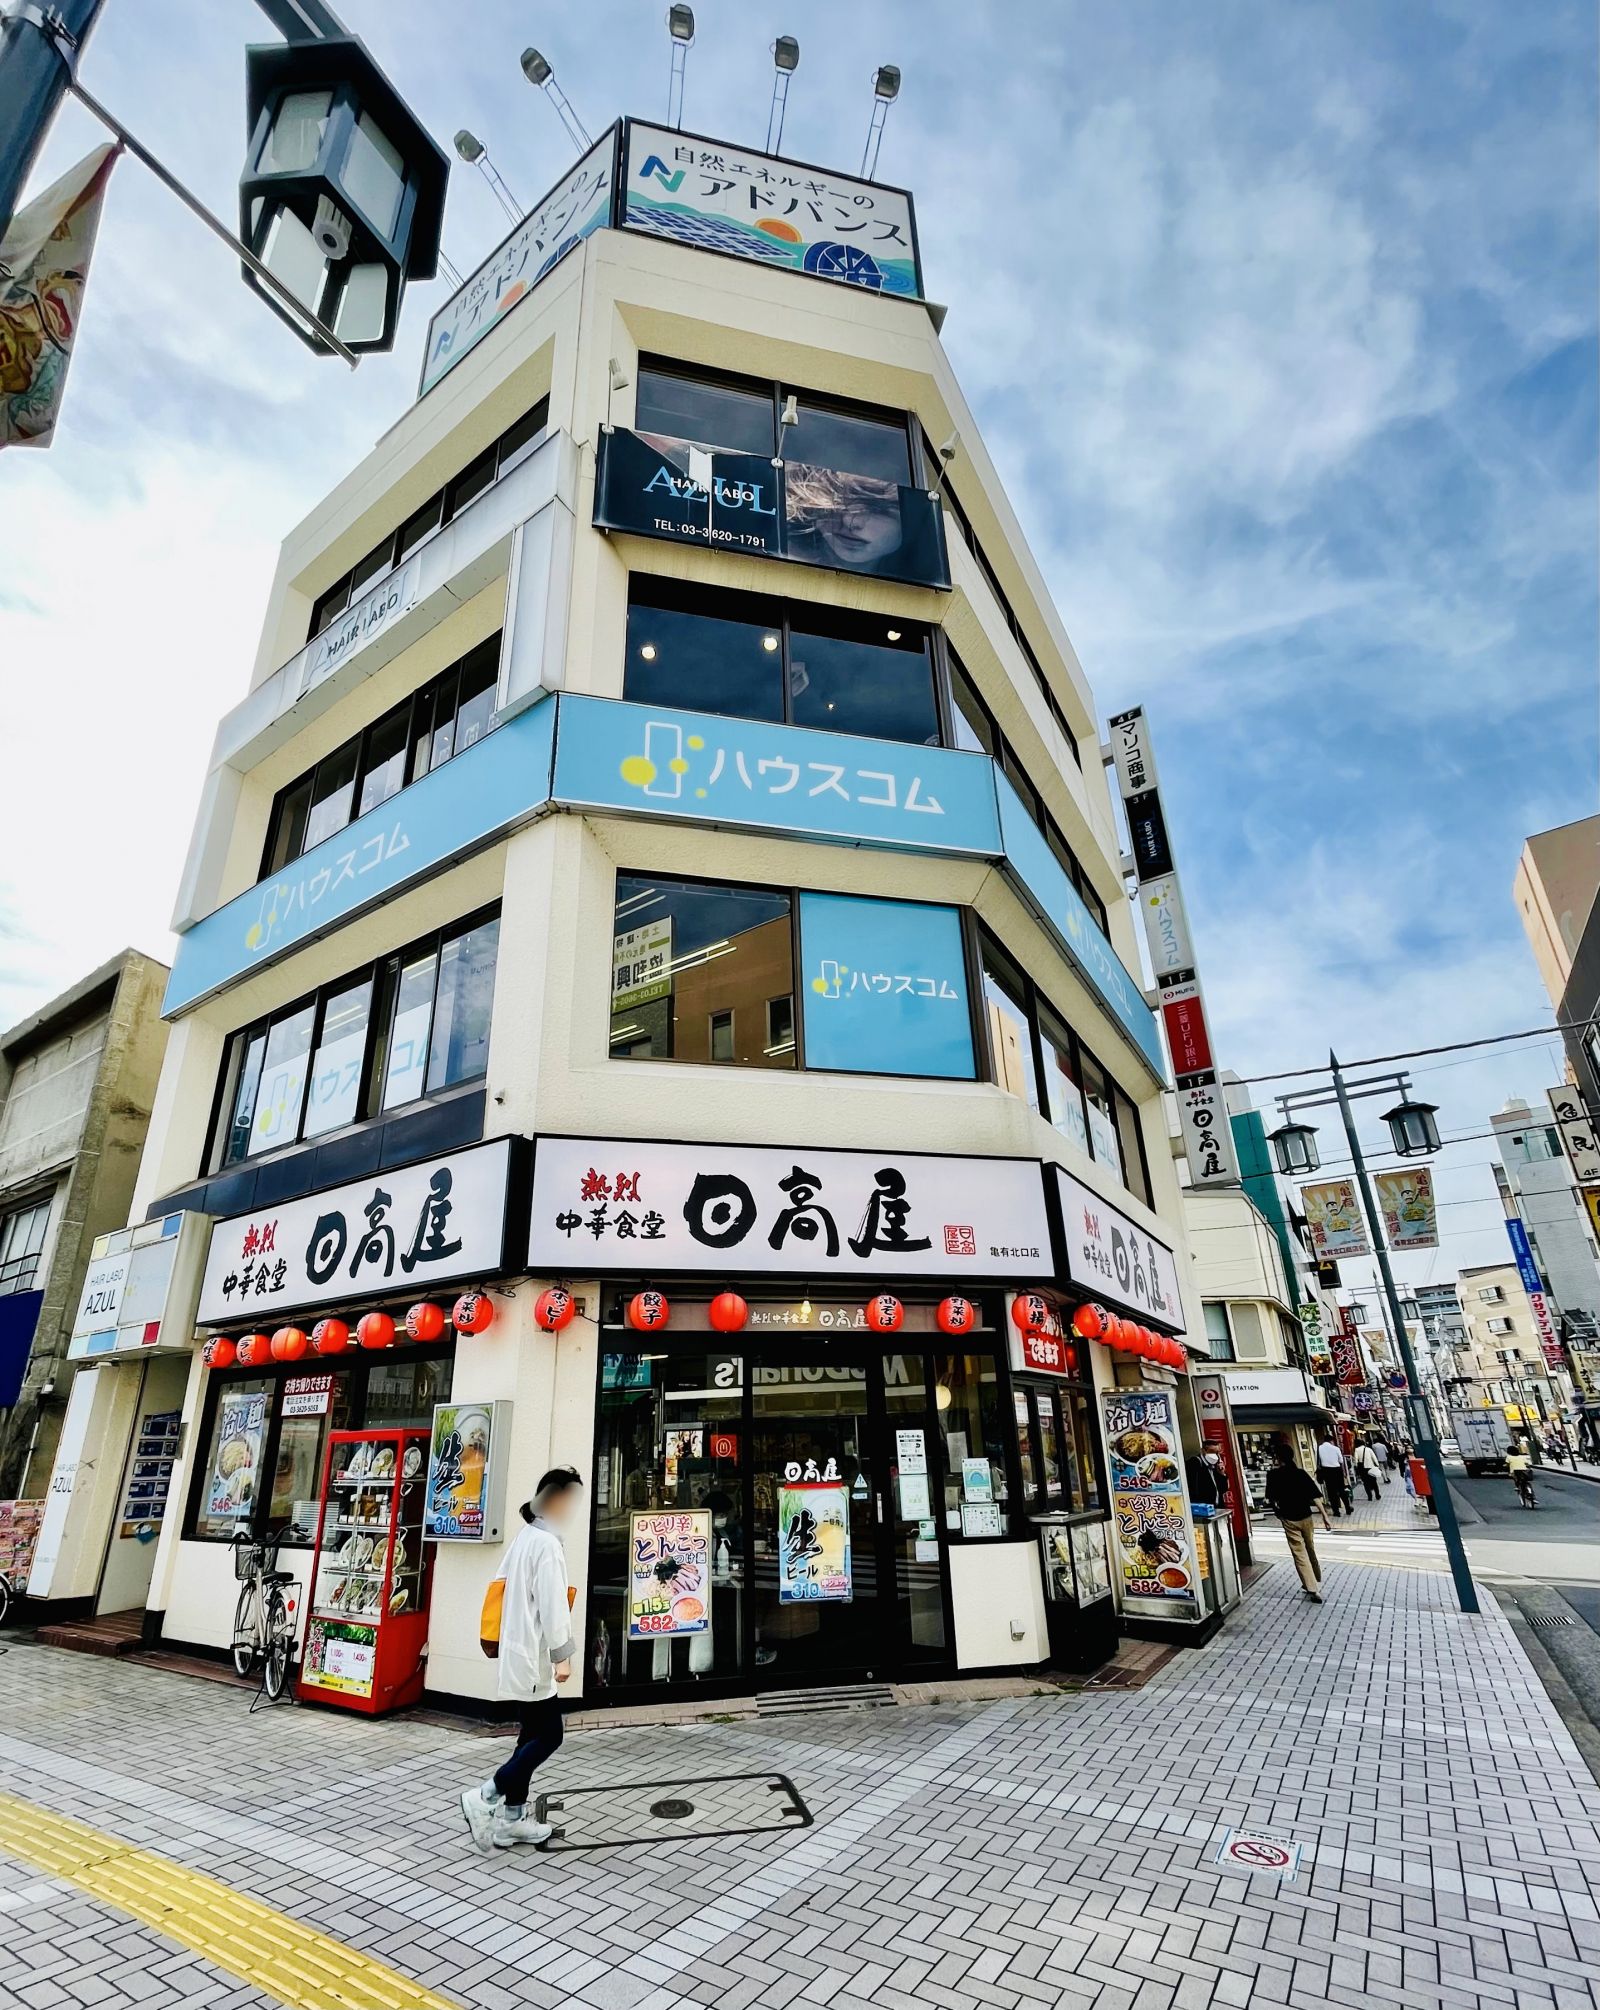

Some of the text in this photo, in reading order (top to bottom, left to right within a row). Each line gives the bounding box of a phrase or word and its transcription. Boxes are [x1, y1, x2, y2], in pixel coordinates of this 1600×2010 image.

[673, 146, 876, 210] 自然エネルギーの
[698, 173, 909, 248] アドバンス
[713, 485, 755, 502] LABO
[709, 748, 946, 815] ハウスコム
[283, 822, 411, 921] ハウスコム
[1157, 907, 1181, 966] ハウスコム
[850, 972, 959, 1000] ハウスコム
[1192, 1109, 1227, 1178] 日高屋
[580, 1167, 642, 1203] 熱烈
[305, 1167, 463, 1286] 日高屋
[555, 1202, 667, 1242] 中華食堂
[683, 1165, 932, 1259] 日高屋
[242, 1219, 278, 1259] 熱烈
[990, 1246, 1040, 1258] 亀有北口店
[88, 1268, 124, 1287] HAIR LABO
[222, 1256, 288, 1302] 中華食堂
[1110, 1225, 1167, 1313] 日高屋
[83, 1288, 117, 1316] AZUL
[547, 1291, 568, 1324] ホッピー
[642, 1292, 663, 1326] 餃子
[879, 1296, 897, 1327] 油そば
[1105, 1399, 1169, 1432] 冷し麺
[432, 1429, 466, 1495] 生
[784, 1457, 842, 1482] 日高屋
[52, 1477, 73, 1494] AZUL
[1128, 1494, 1168, 1512] ピリ辛
[649, 1514, 693, 1535] ピリ辛
[782, 1507, 824, 1565] 生
[1116, 1512, 1185, 1536] とんこつ
[633, 1533, 708, 1563] とんこつ
[673, 1551, 707, 1564] つけ麺
[786, 1564, 819, 1580] ビール
